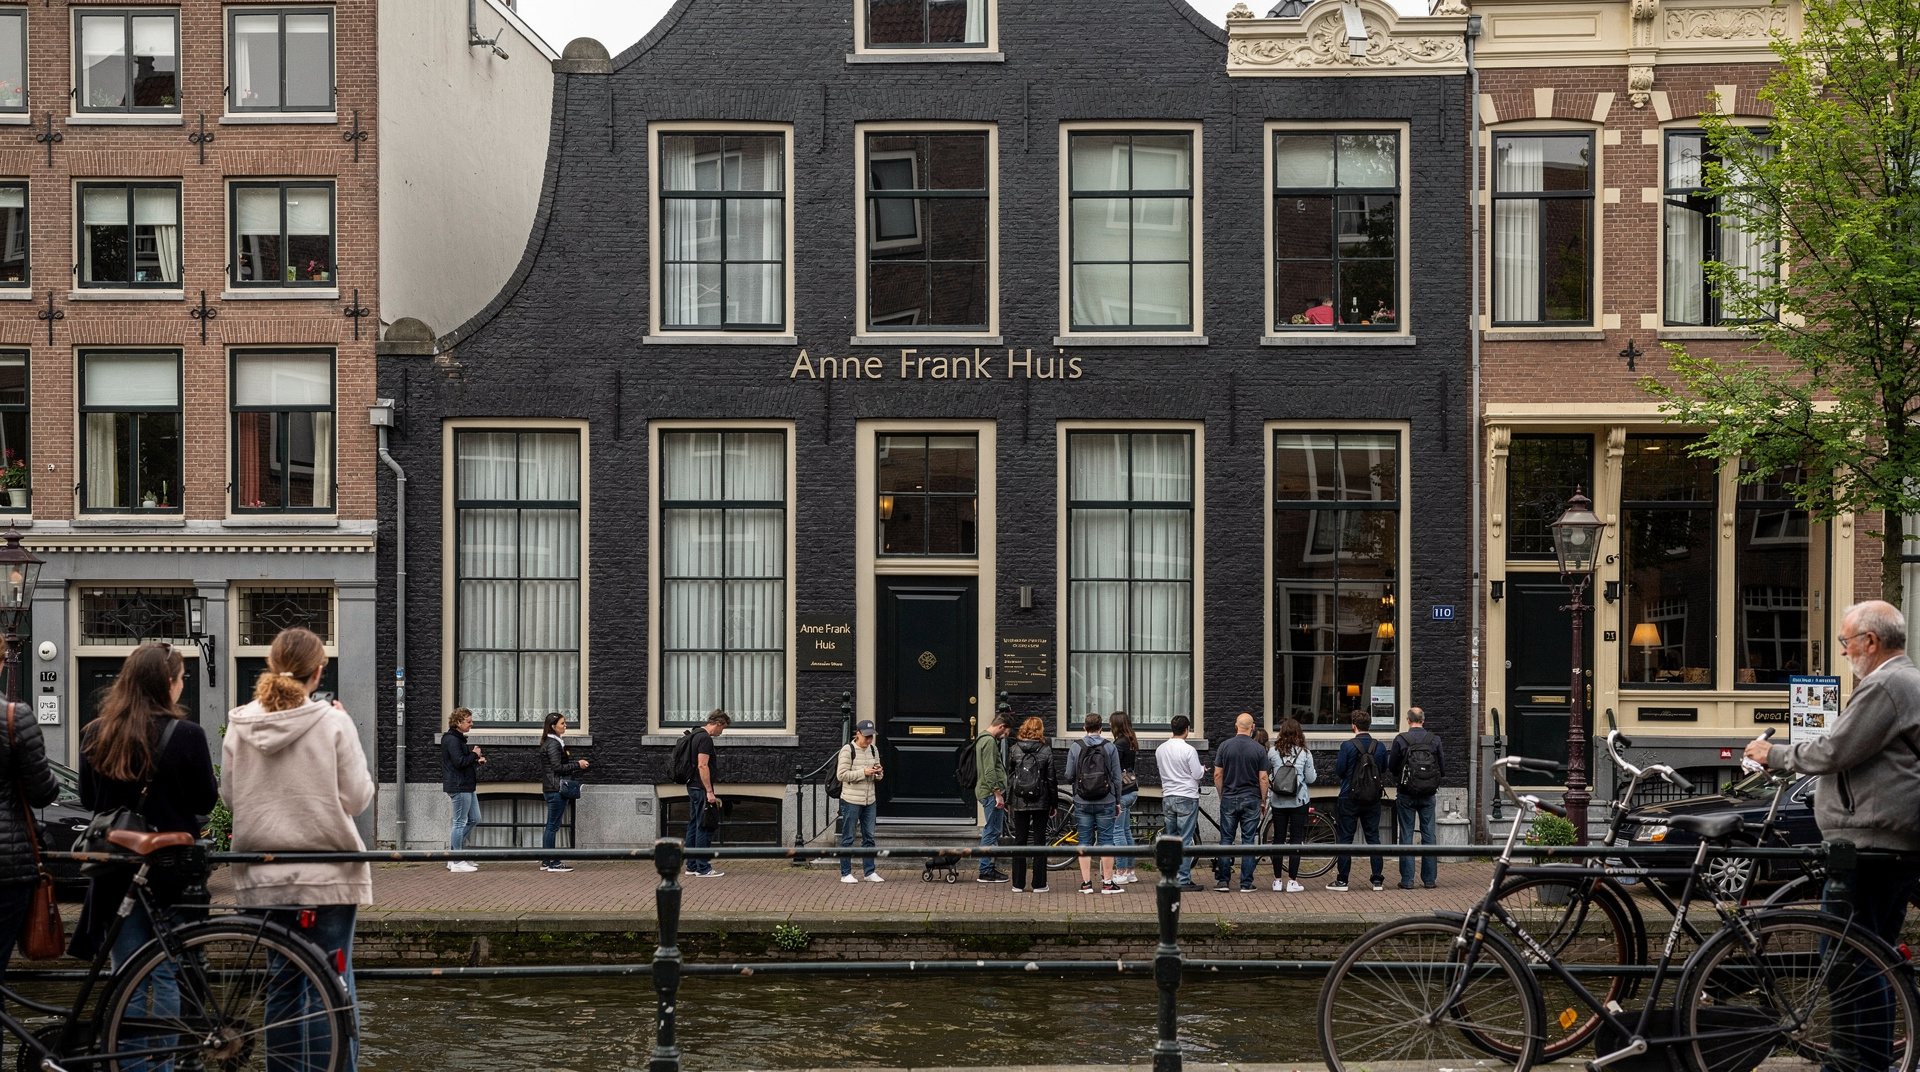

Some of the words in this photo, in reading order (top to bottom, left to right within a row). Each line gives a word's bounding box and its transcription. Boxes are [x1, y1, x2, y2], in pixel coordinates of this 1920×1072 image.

[790, 348, 883, 379] Anne
[901, 347, 992, 379] Frank
[1008, 348, 1083, 379] Huis
[1434, 608, 1451, 617] 110
[800, 623, 824, 634] Anne
[825, 623, 851, 634] Frank
[815, 639, 836, 650] Huis
